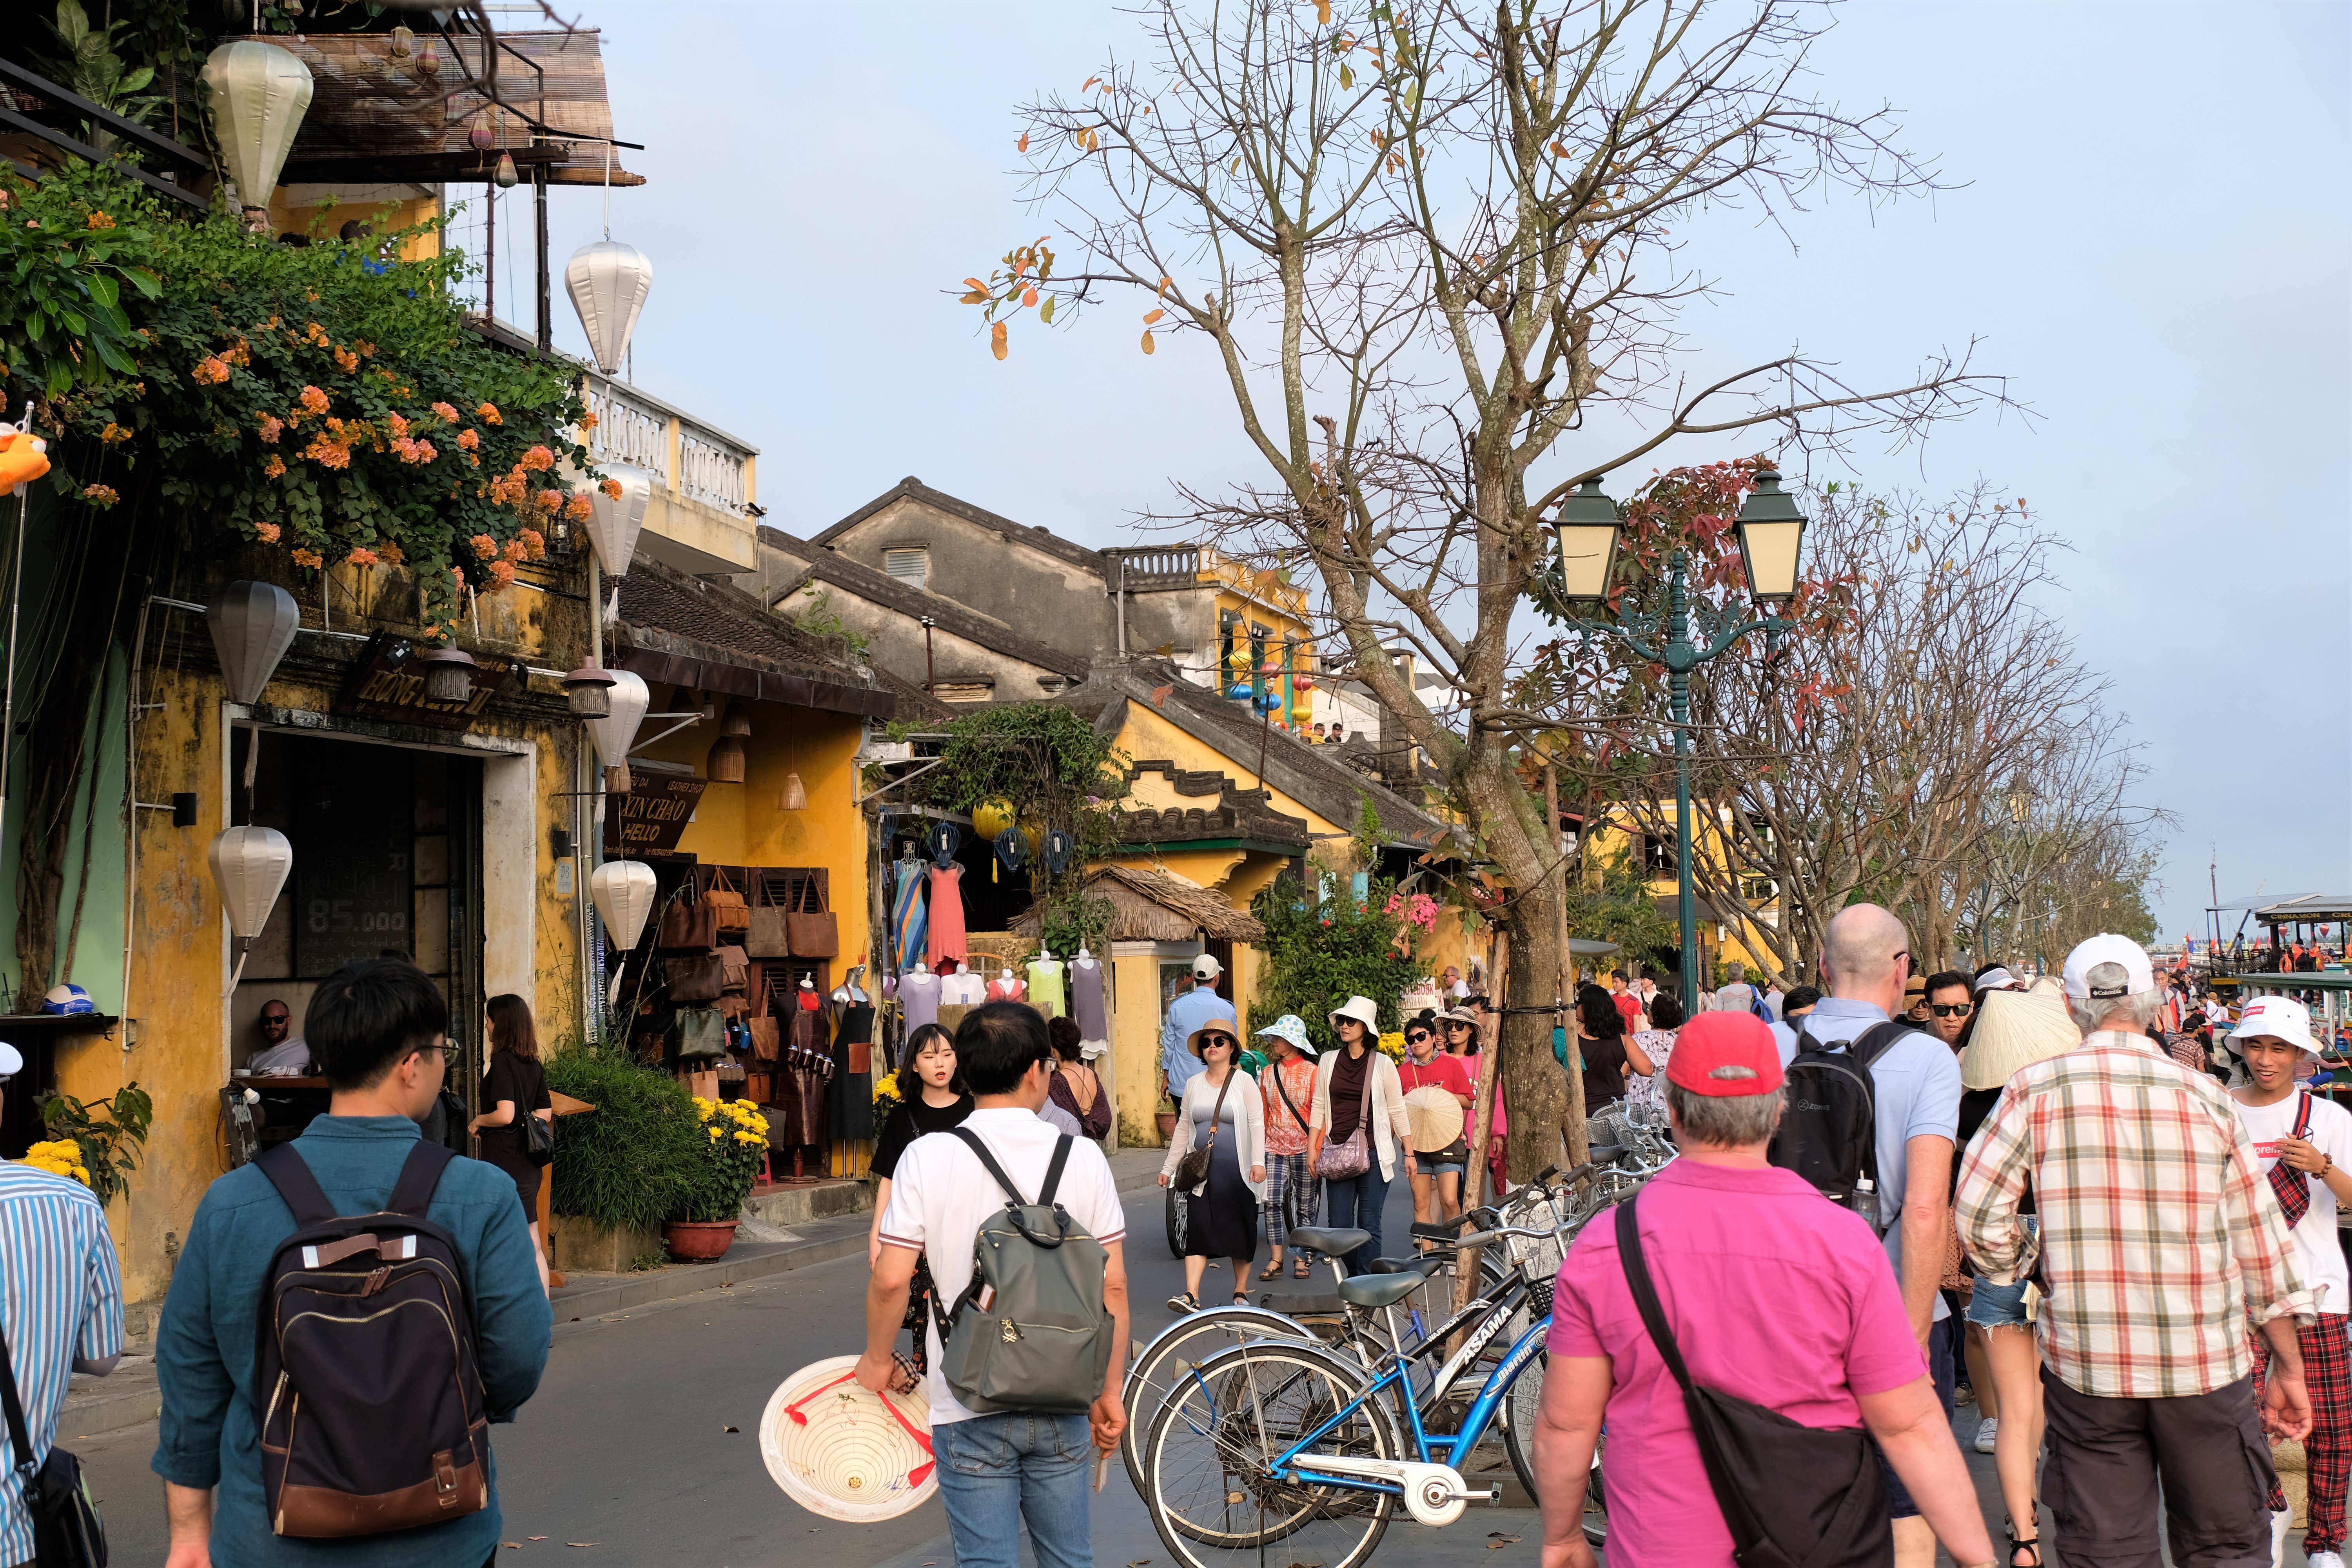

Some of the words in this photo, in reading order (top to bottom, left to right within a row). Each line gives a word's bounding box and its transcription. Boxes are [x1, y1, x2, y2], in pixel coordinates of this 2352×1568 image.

[667, 780, 691, 792] LEATHER
[690, 783, 706, 793] SHOP
[621, 796, 648, 818] XIN
[647, 793, 686, 821] CHÀO
[622, 823, 661, 842] HELLO
[308, 899, 406, 933] 85.000
[1426, 1316, 1460, 1342] WARRIOR
[1463, 1305, 1513, 1365] ASAMA
[1497, 1345, 1533, 1381] martin
